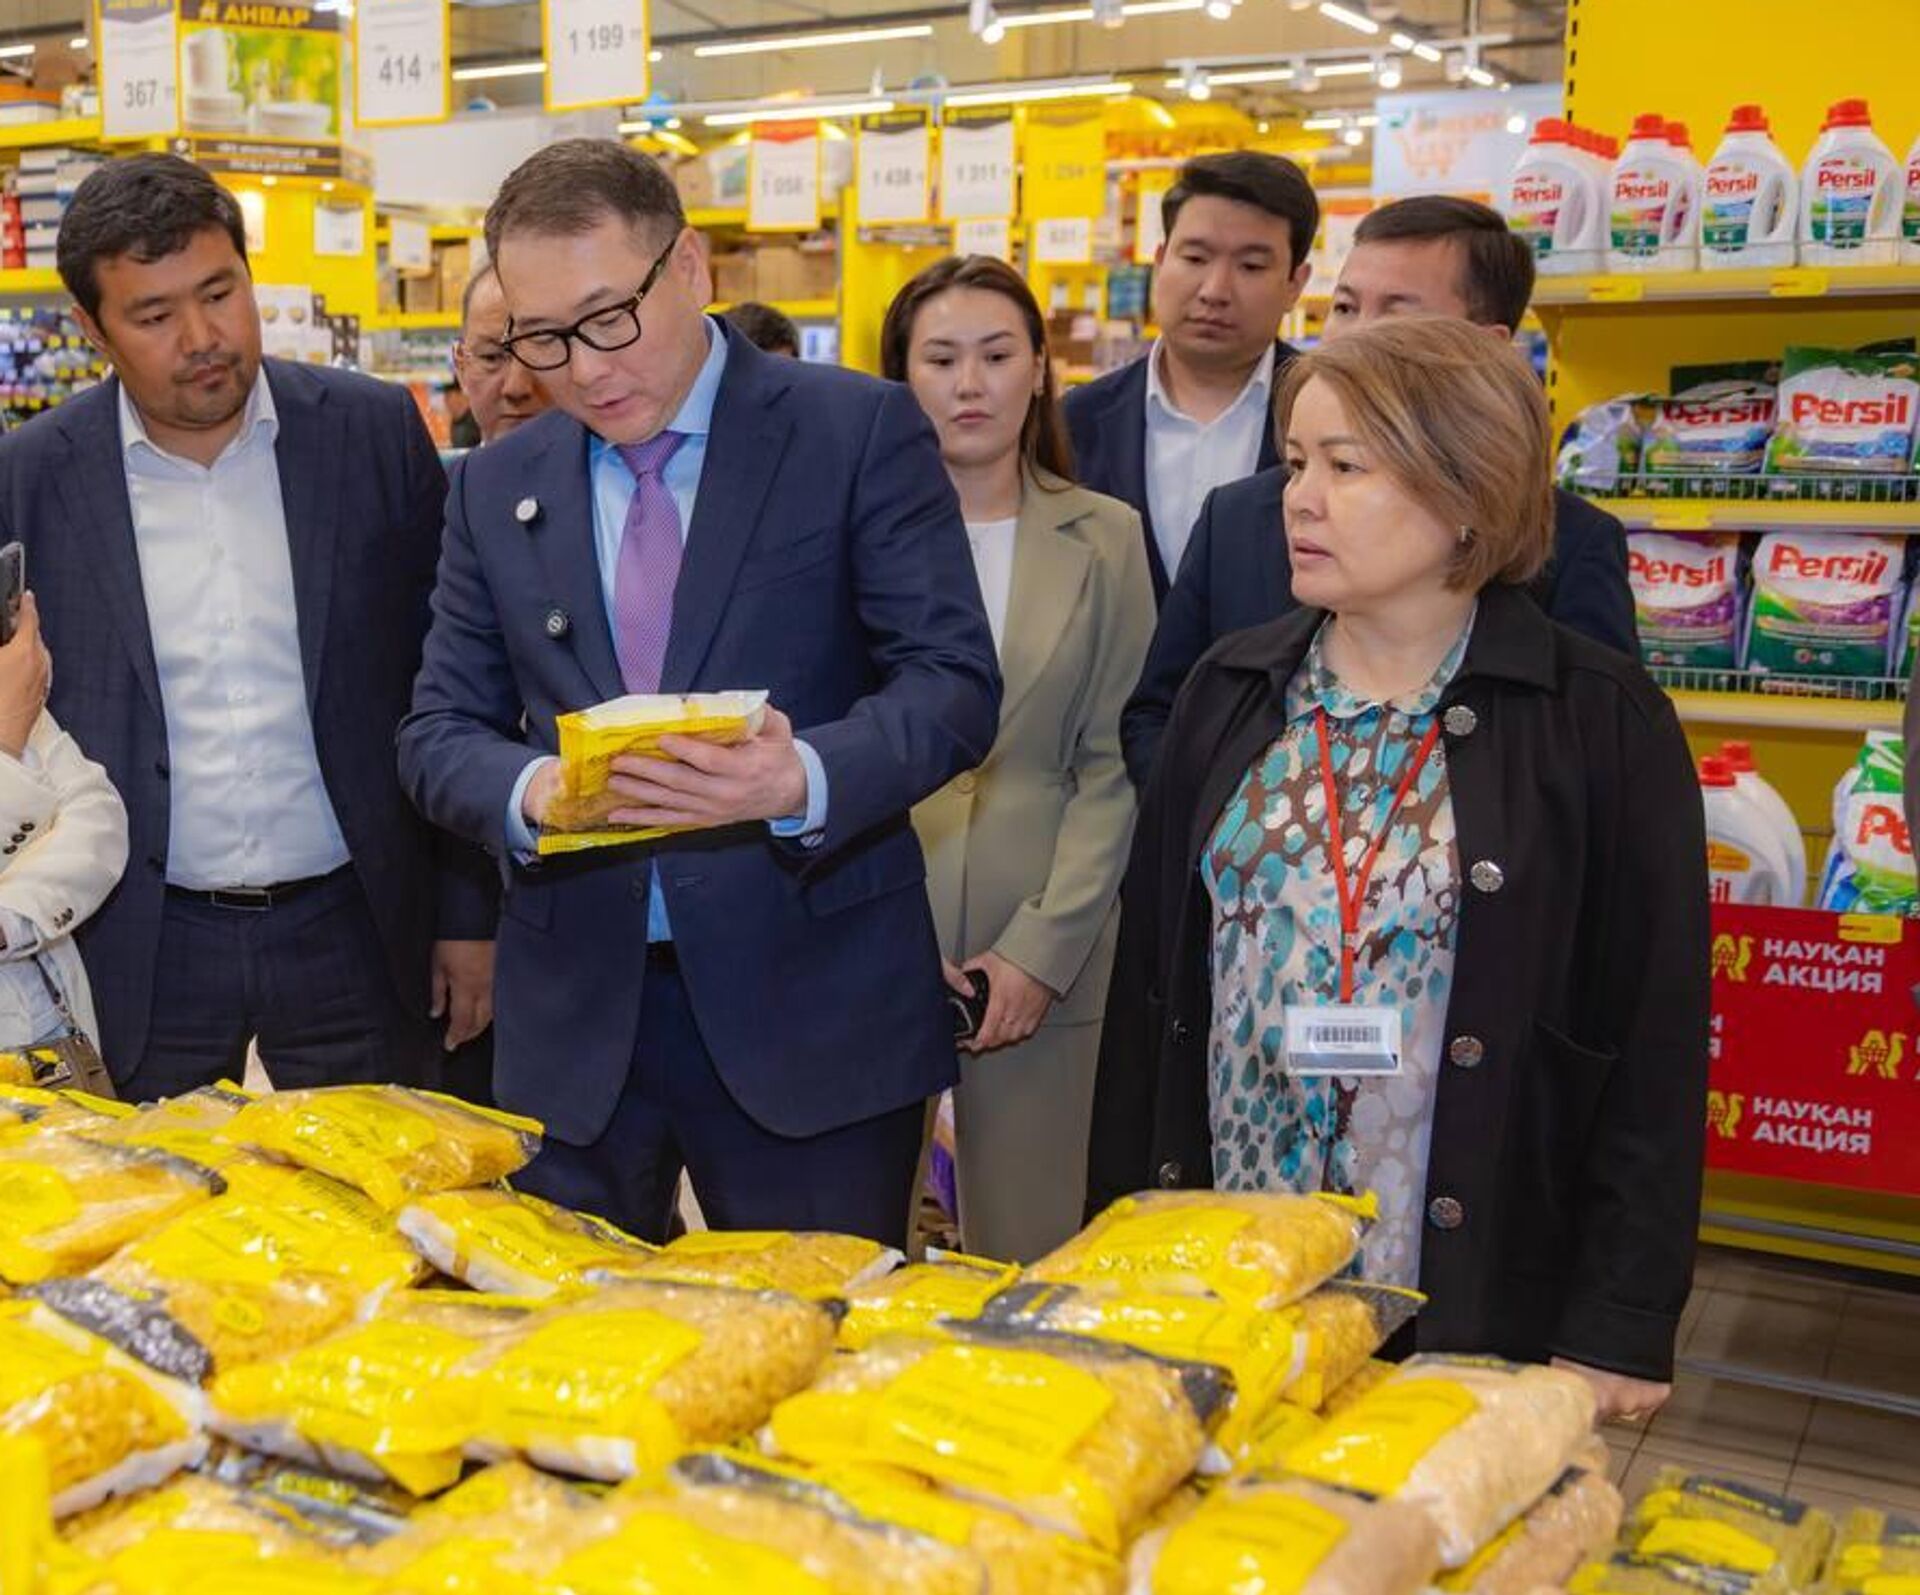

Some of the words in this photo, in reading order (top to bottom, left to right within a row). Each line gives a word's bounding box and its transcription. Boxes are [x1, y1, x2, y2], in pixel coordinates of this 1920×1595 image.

[587, 24, 624, 50] 199
[379, 54, 421, 84] 414
[123, 79, 158, 108] 367
[1616, 181, 1668, 199] Persil
[1707, 174, 1757, 195] Persil
[1818, 167, 1875, 188] Persil
[1513, 183, 1562, 202] Persil
[1792, 392, 1909, 425] Persil
[1768, 543, 1889, 586] Persil
[1763, 938, 1885, 967] НАУҚАН
[1763, 962, 1883, 993] АКЦИЯ
[1753, 1096, 1873, 1128] НАУҚАН
[1752, 1121, 1872, 1154] АКЦИЯ
